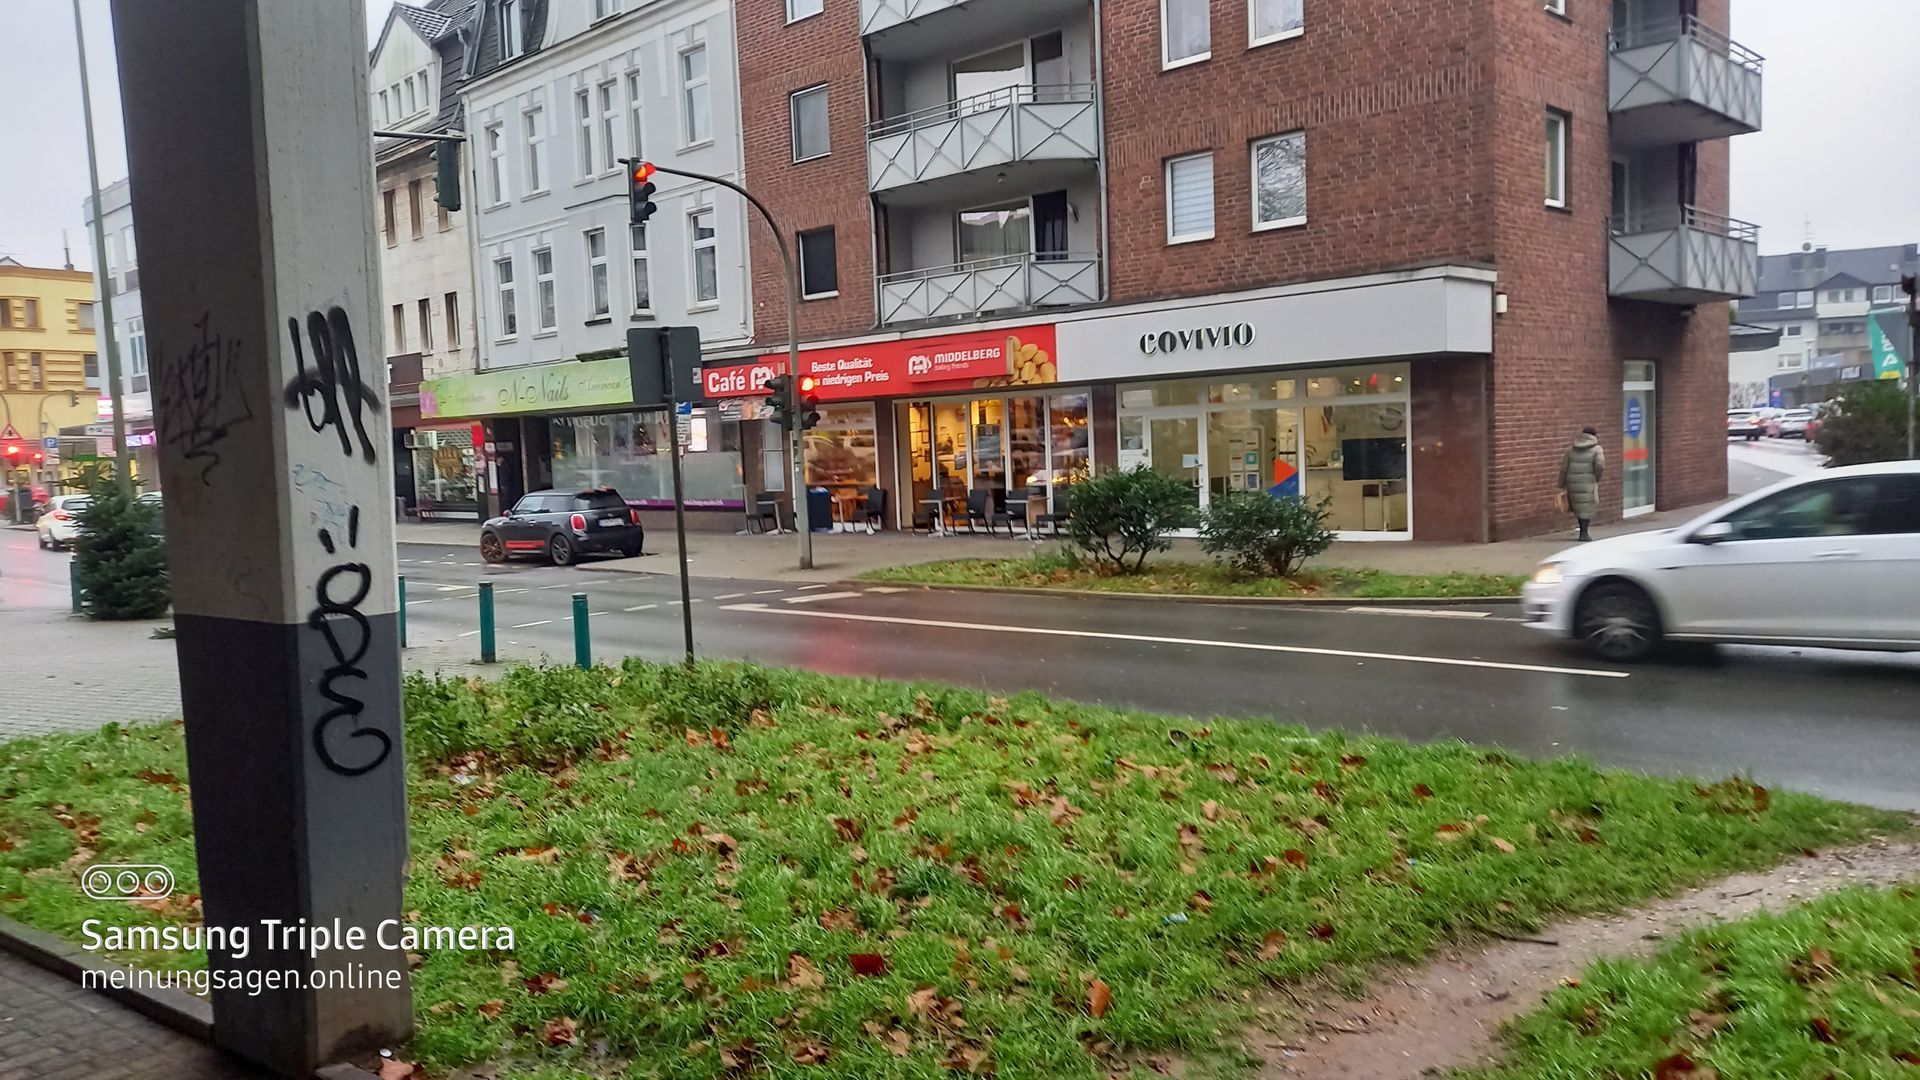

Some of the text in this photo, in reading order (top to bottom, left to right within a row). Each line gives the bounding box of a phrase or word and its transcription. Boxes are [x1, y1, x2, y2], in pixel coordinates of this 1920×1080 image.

[1139, 322, 1256, 355] COVIVIO
[933, 347, 1001, 364] MIDDELBERG
[811, 357, 873, 373] Beste Qualität
[708, 369, 746, 393] Café
[822, 373, 863, 387] niedrigen
[864, 370, 890, 382] Preis
